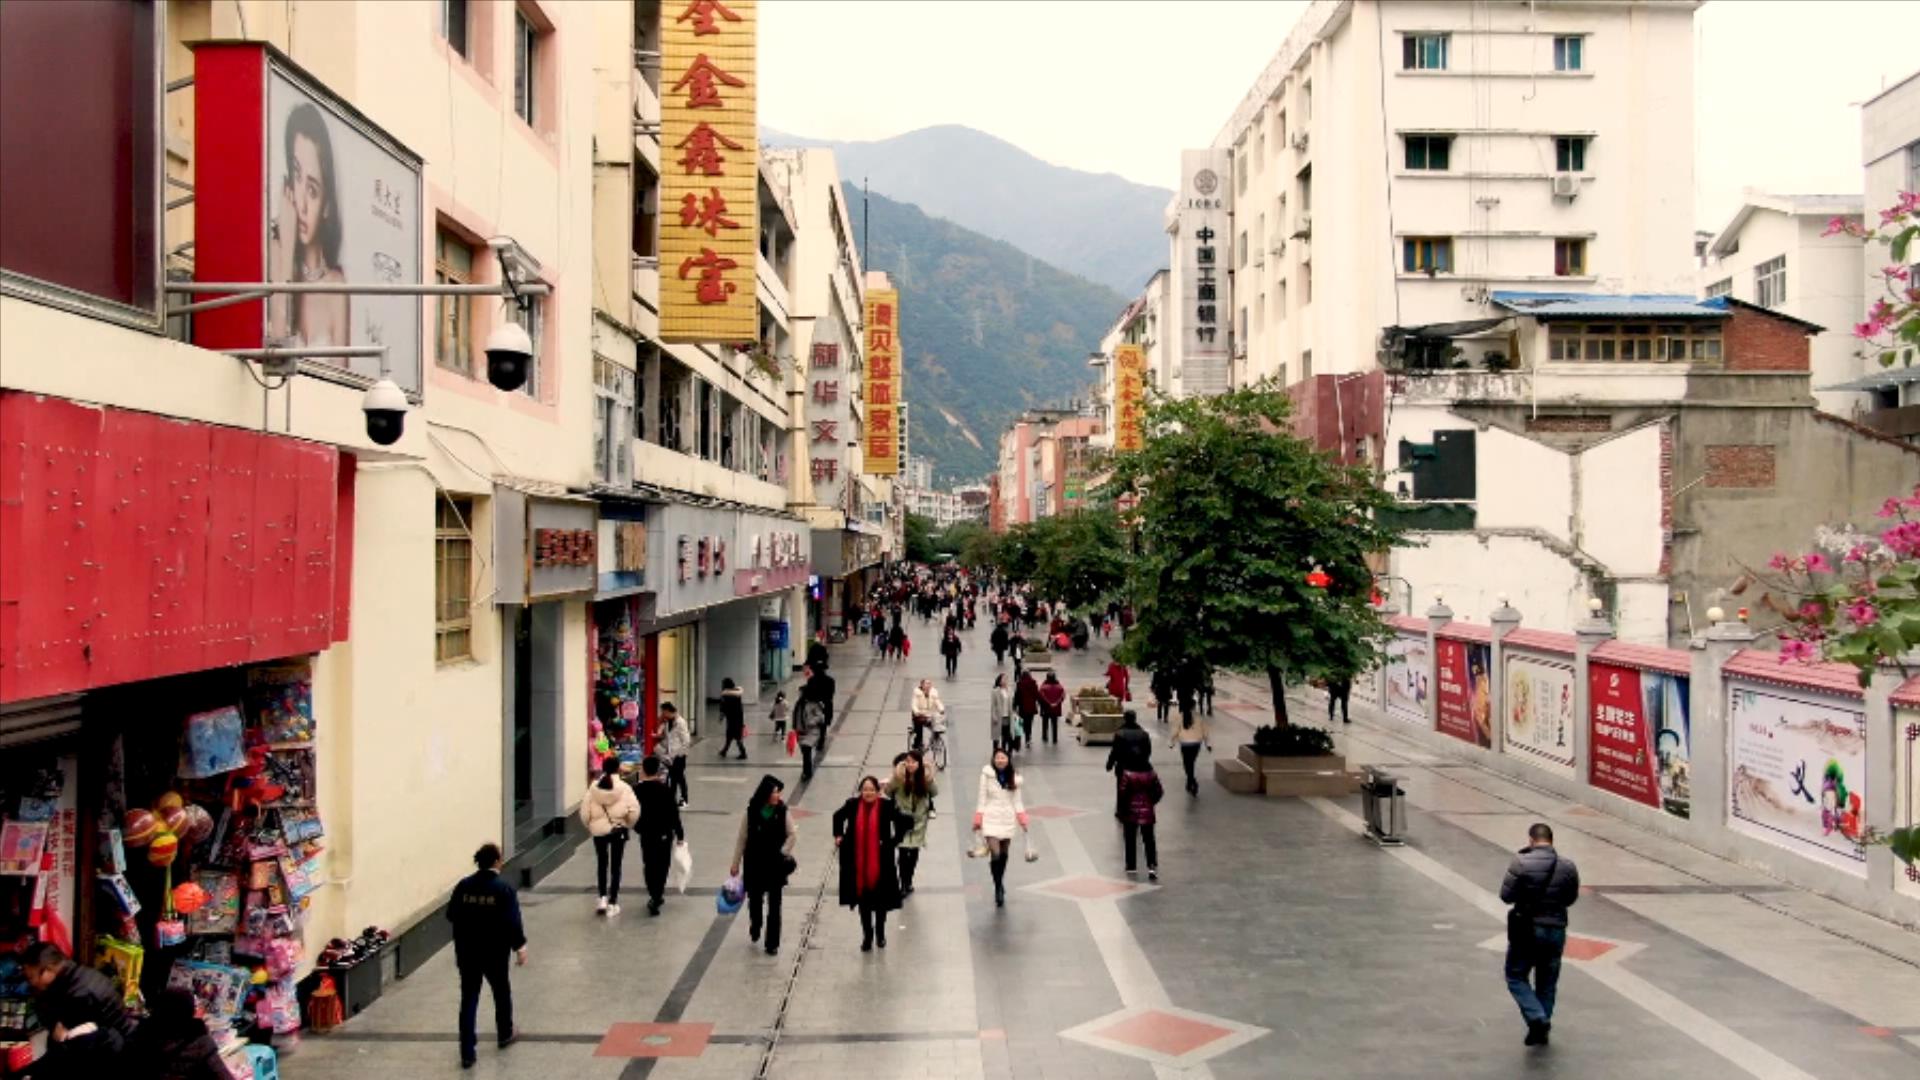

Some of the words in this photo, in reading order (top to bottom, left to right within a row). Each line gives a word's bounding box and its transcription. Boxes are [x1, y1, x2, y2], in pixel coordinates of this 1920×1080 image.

[1195, 226, 1216, 343] 中国工商银行
